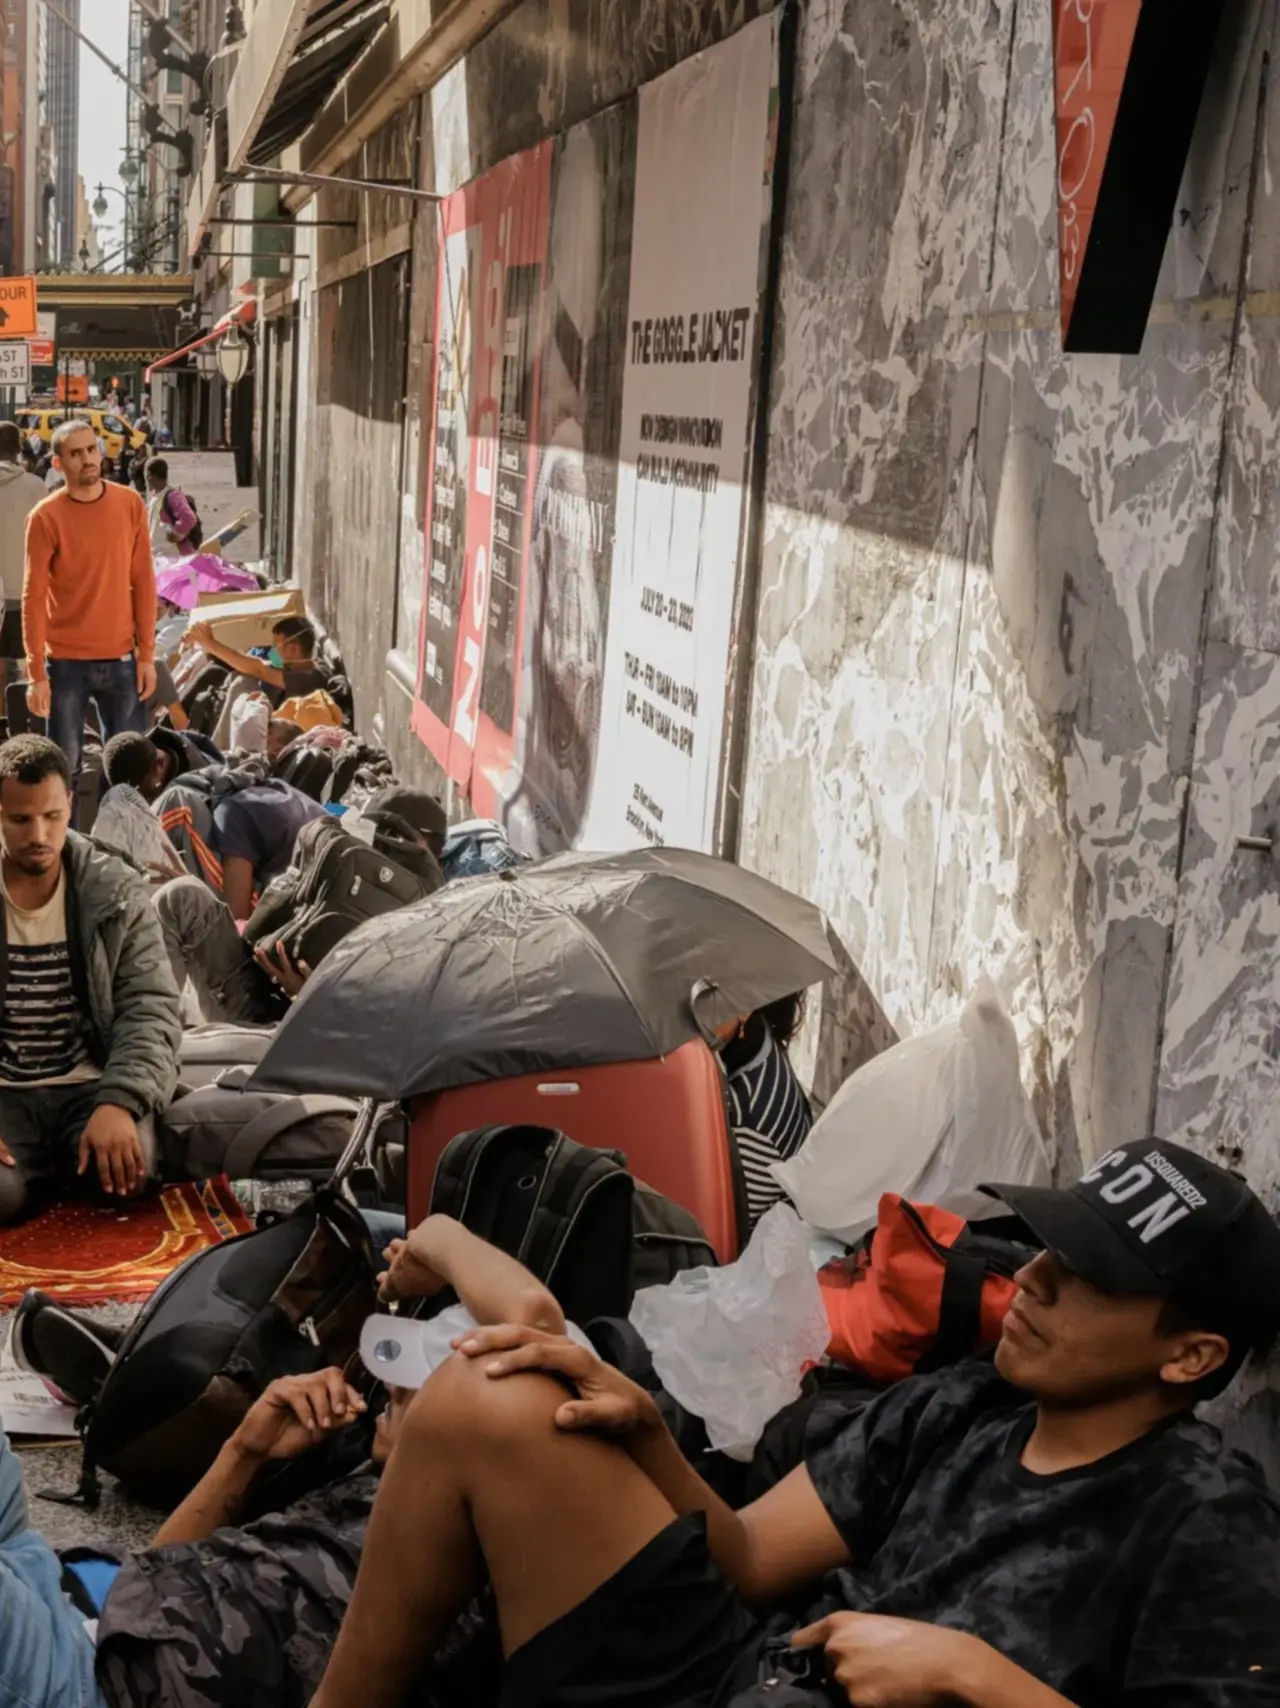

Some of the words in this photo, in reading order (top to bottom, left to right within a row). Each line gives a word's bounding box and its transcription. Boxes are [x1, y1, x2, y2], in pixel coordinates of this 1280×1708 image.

[631, 318, 653, 364] THE
[653, 314, 698, 364] GOGGLE
[698, 307, 750, 364] JACKET
[11, 366, 25, 379] ST
[1143, 1149, 1208, 1210] DSQUARED2
